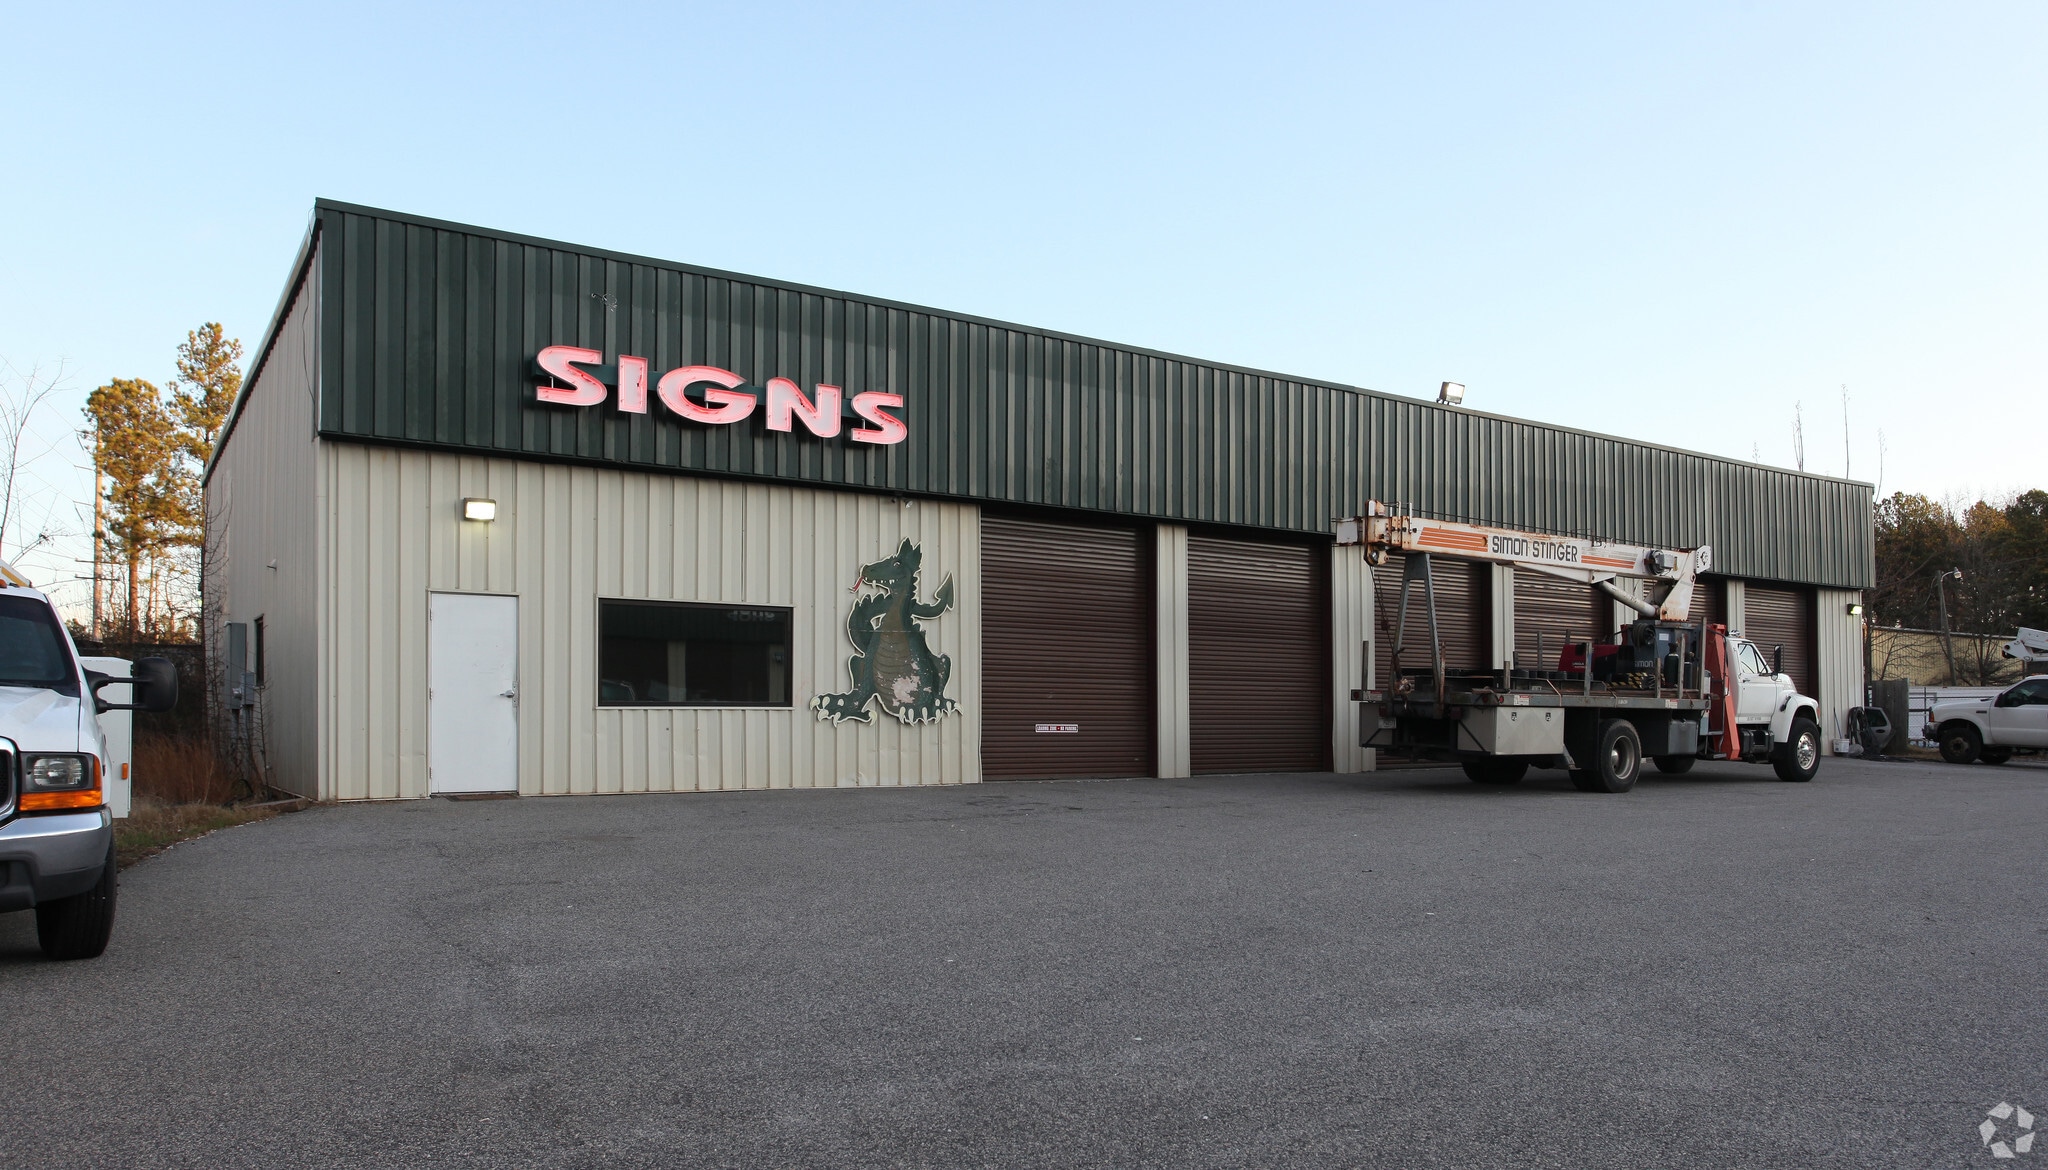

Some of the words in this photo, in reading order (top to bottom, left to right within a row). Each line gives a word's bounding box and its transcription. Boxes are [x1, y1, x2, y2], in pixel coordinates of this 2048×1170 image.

[536, 345, 908, 445] SIGNS
[1492, 535, 1528, 557] SIMON
[1532, 540, 1578, 562] STINGER
